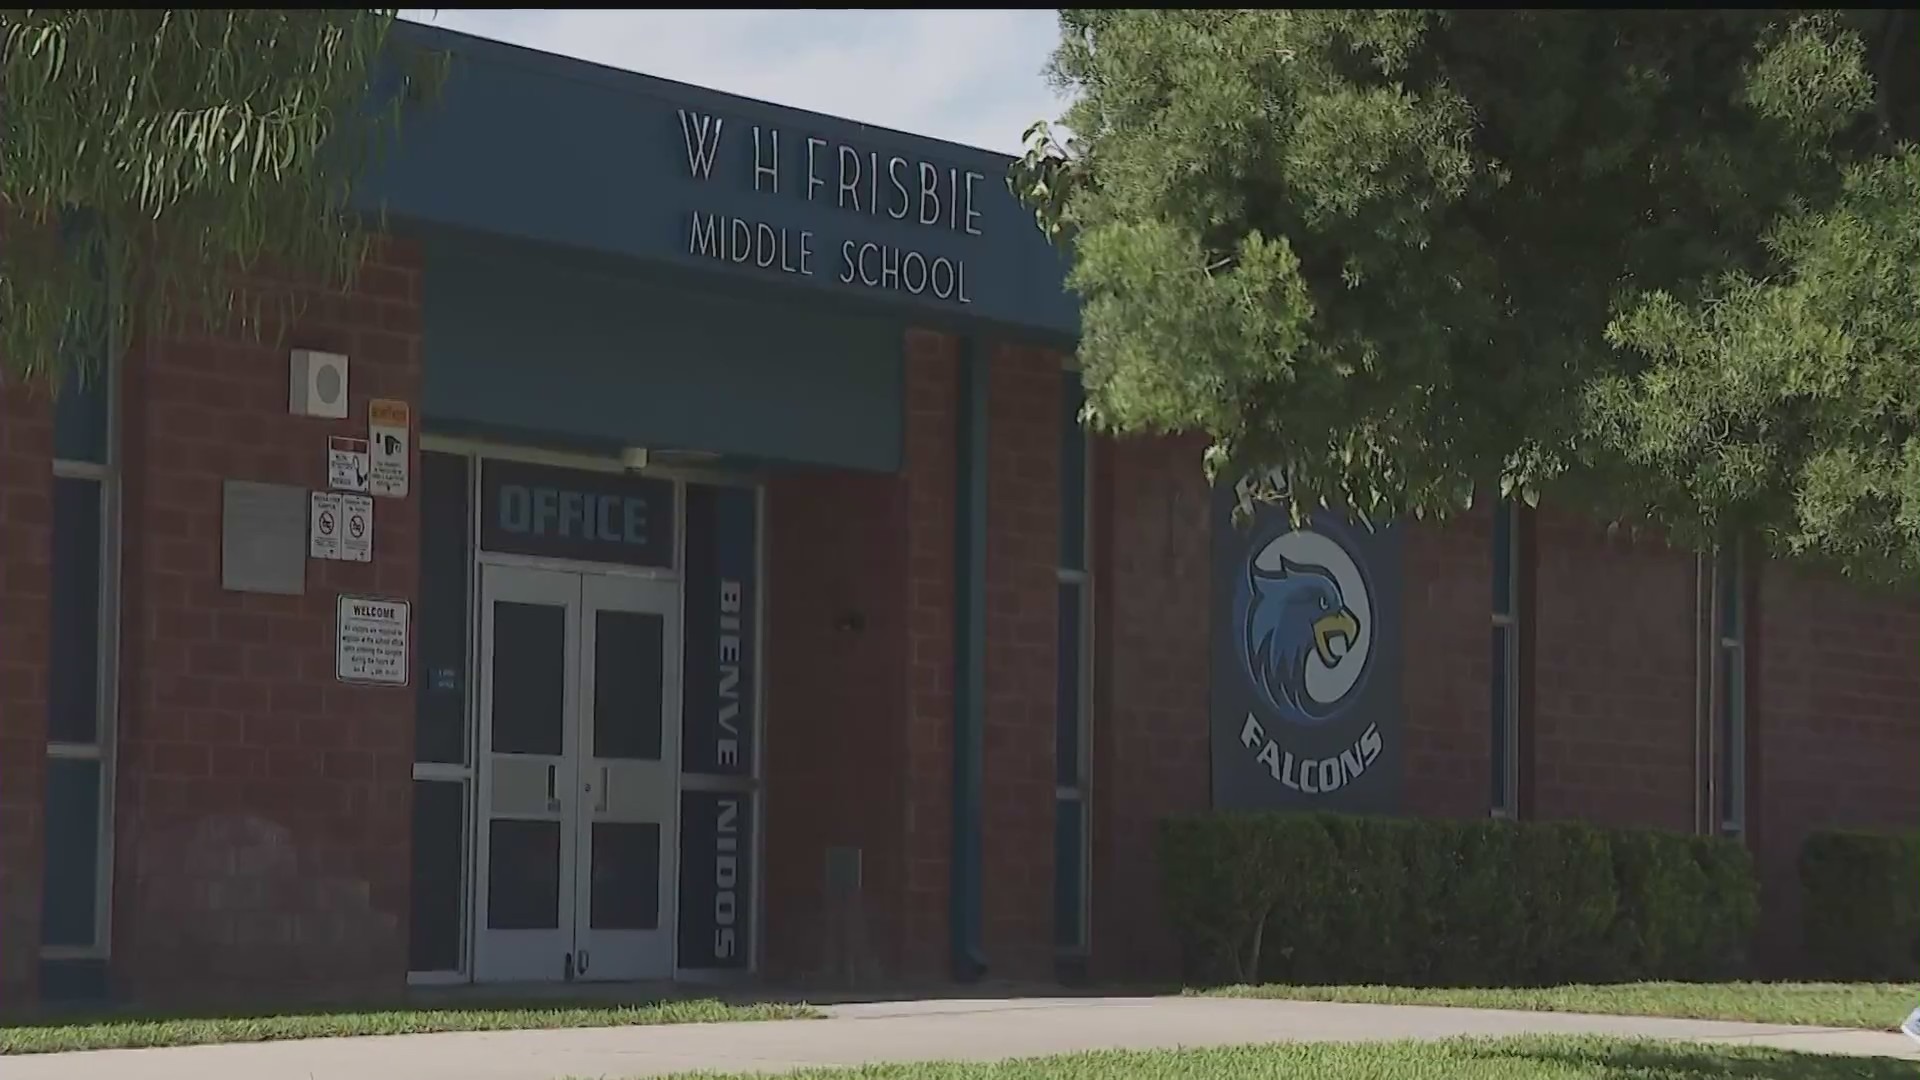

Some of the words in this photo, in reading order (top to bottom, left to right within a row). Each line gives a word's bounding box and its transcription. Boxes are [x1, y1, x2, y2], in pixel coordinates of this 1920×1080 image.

[677, 109, 723, 180] W
[753, 126, 779, 193] H
[807, 137, 985, 235] FRISBIE
[690, 210, 813, 275] MIDDLE
[840, 240, 971, 303] SCHOOL
[499, 485, 647, 544] OFFICE
[353, 605, 395, 619] WELCOME
[716, 579, 741, 768] BIENVE
[1240, 712, 1384, 794] FALCONS
[714, 800, 739, 959] NIDOS
